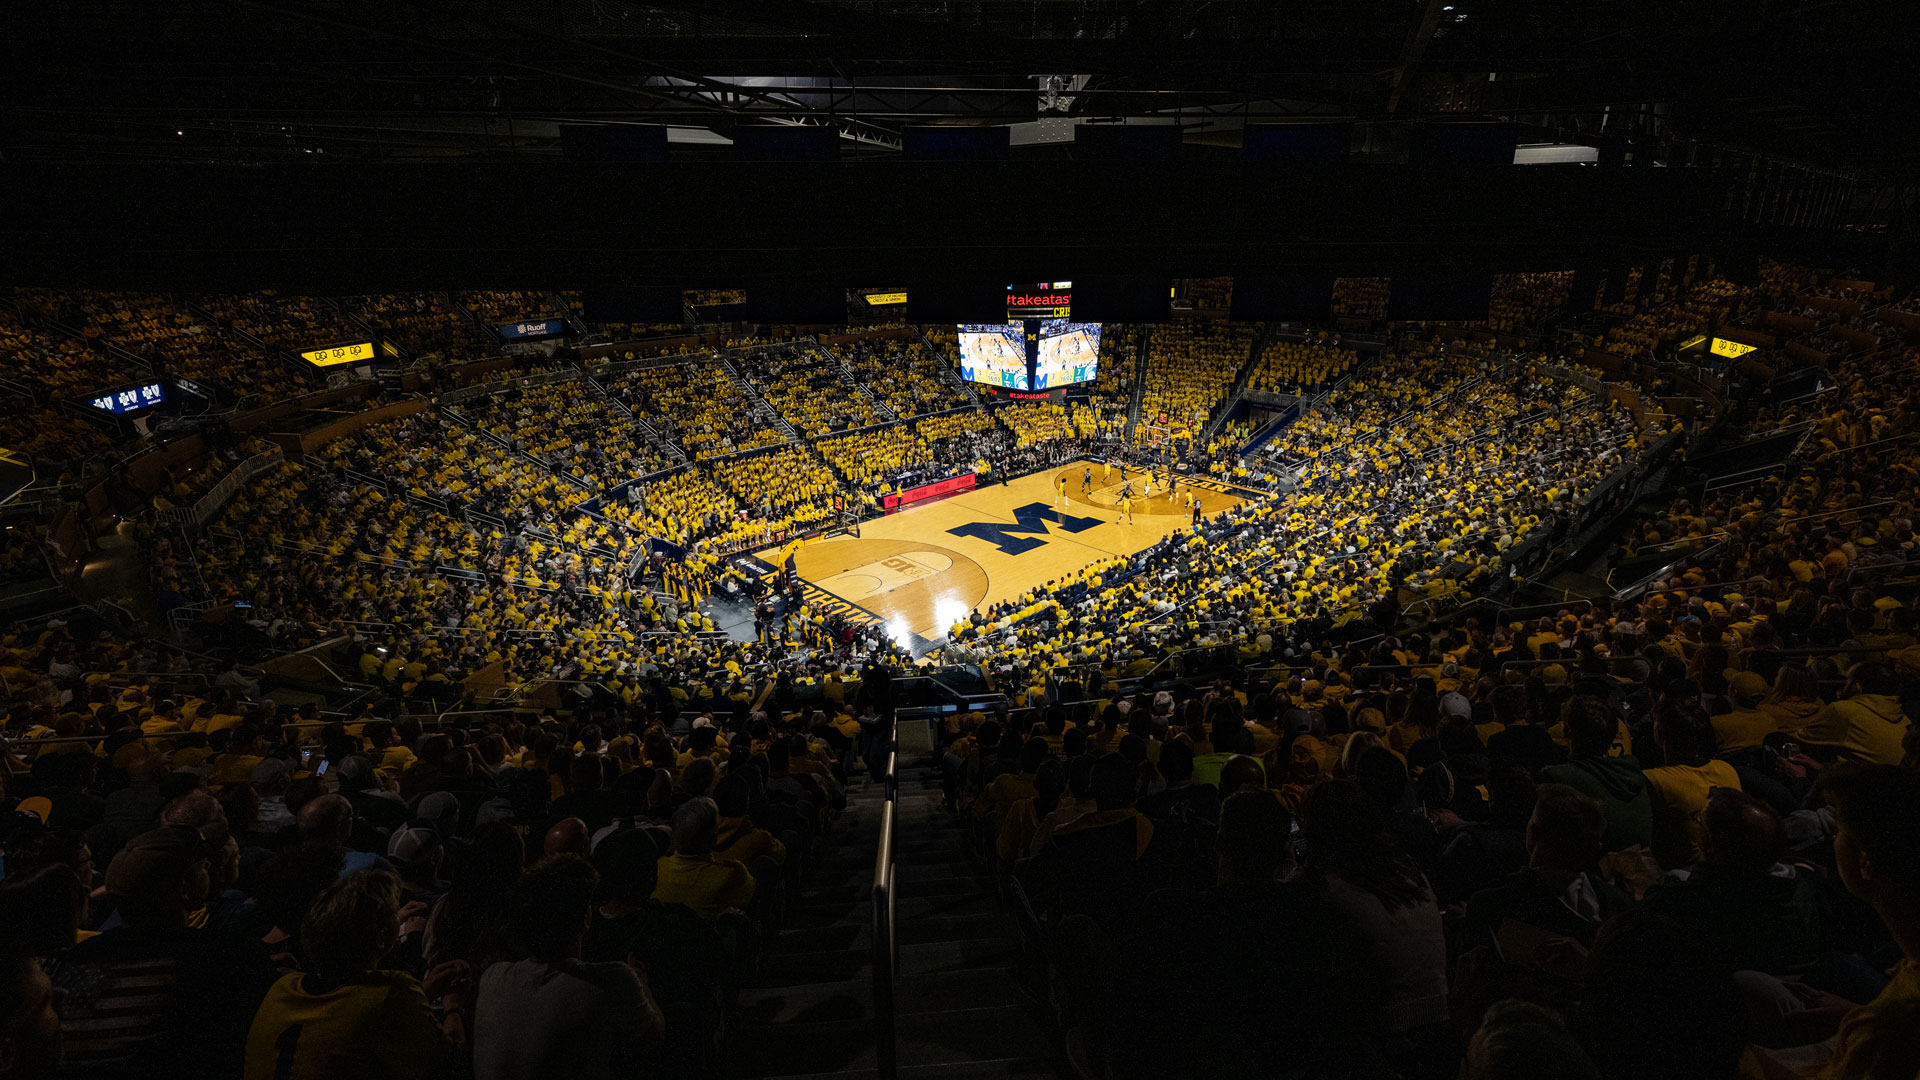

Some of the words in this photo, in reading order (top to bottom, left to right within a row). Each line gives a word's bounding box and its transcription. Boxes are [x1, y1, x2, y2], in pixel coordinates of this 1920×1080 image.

[527, 323, 546, 332] Ruoff
[1027, 333, 1037, 341] M
[945, 501, 1106, 556] M
